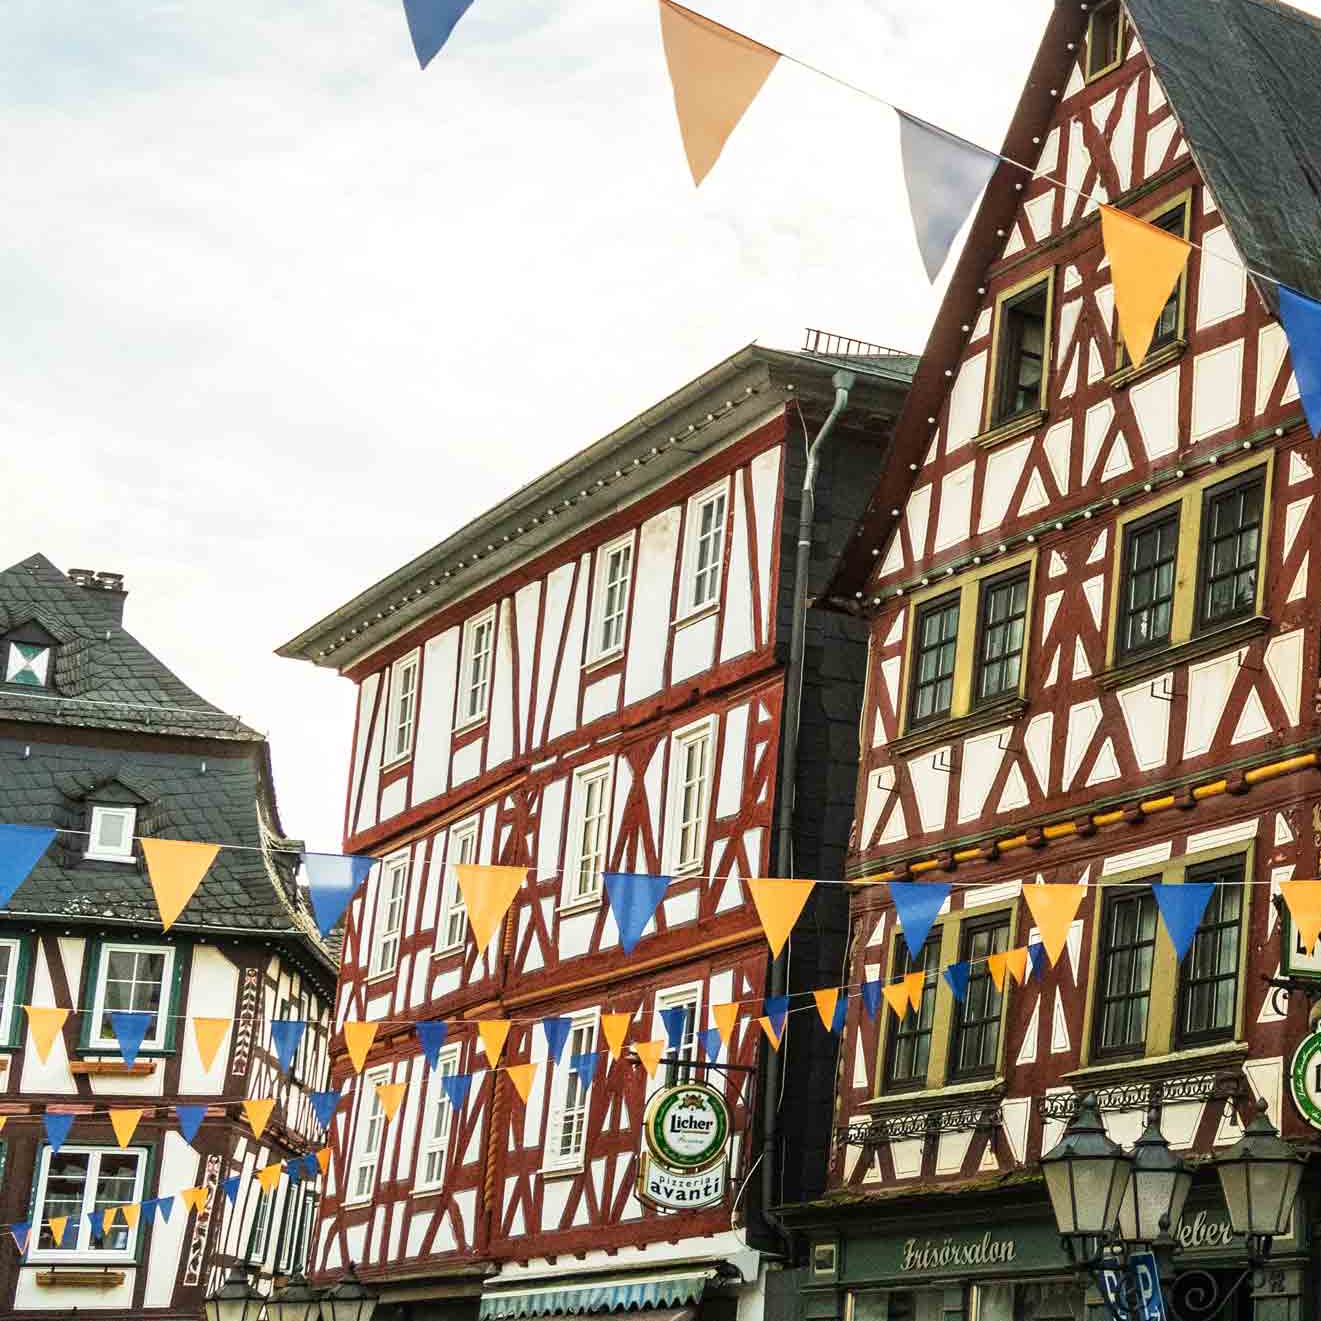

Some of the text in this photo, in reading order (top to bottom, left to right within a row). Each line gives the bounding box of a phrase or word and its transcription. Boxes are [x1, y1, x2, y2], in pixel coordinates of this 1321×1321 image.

[670, 1114, 714, 1133] Licher
[650, 1177, 720, 1201] avanti
[659, 1176, 711, 1188] pizzeria
[900, 1210, 1233, 1271] Frisörsalon eber
